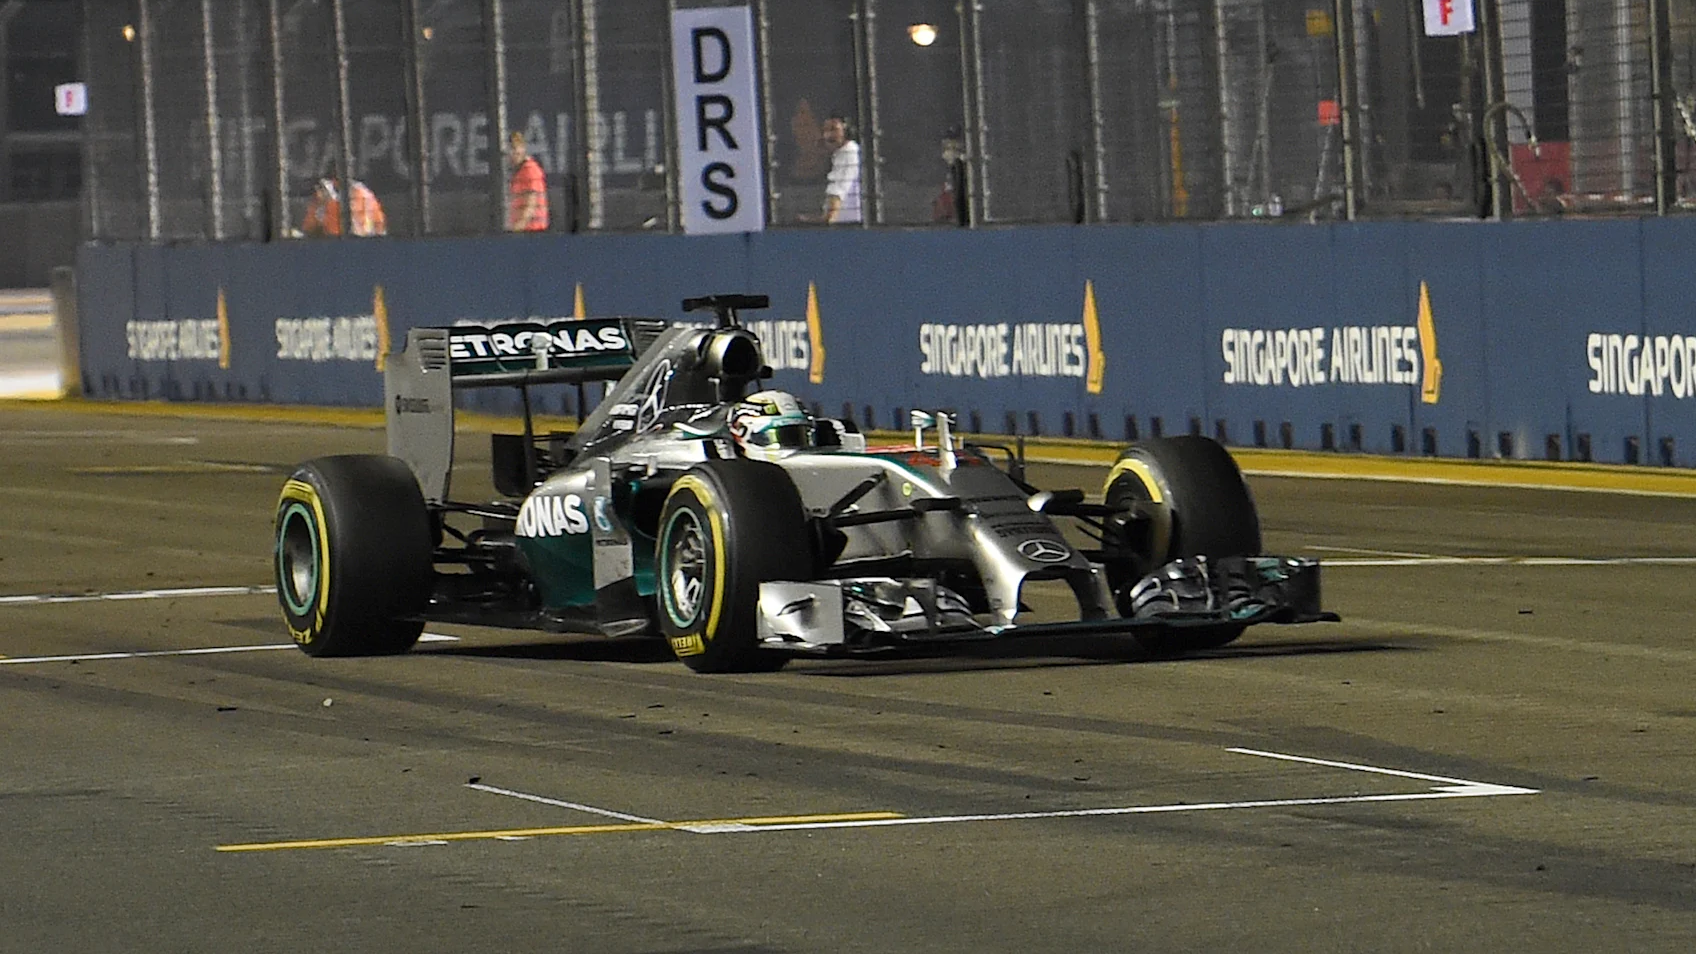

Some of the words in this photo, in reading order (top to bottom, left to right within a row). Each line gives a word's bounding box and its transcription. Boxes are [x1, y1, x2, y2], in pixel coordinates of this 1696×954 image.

[189, 112, 491, 181] NGAPORE
[515, 108, 658, 174] AIRLI
[449, 326, 627, 359] ETRONAS
[747, 320, 810, 371] RLINES
[919, 323, 1010, 378] SINGAPORE
[1012, 323, 1084, 377] AIRLINES
[1222, 327, 1326, 388] SINGAPORE
[1330, 326, 1417, 384] AIRLINES
